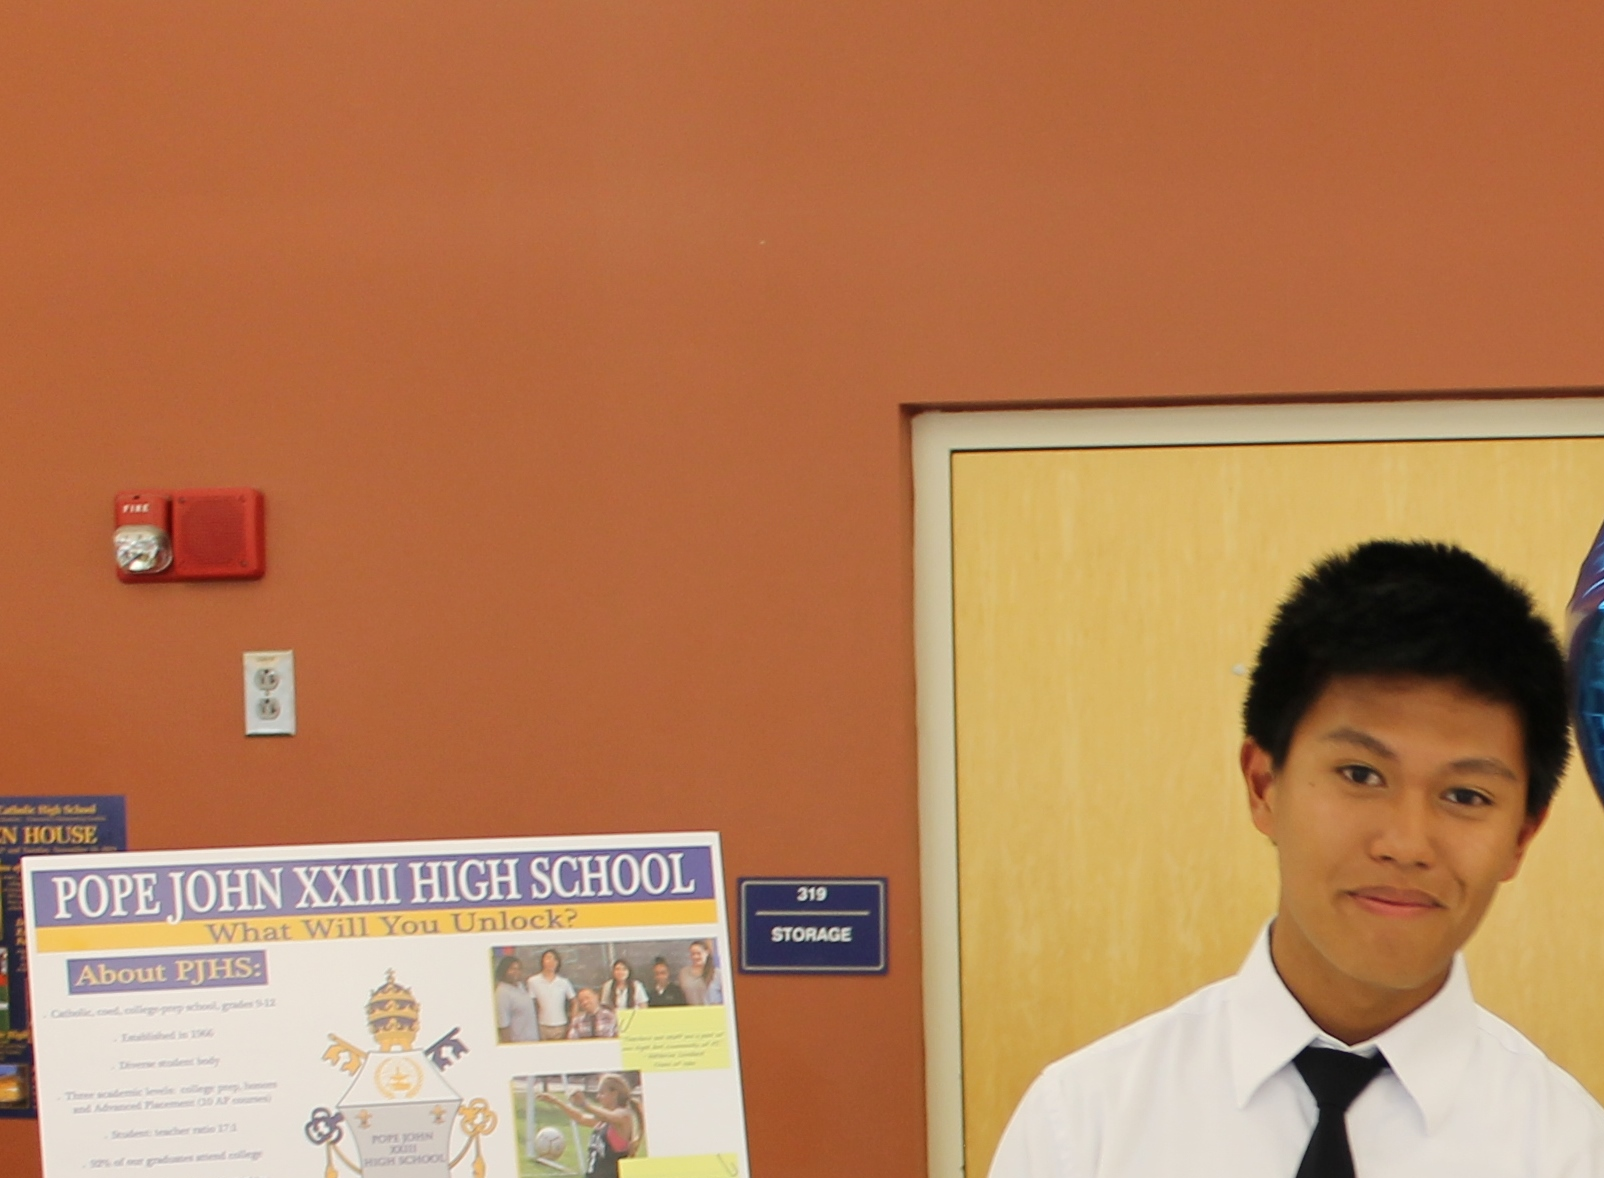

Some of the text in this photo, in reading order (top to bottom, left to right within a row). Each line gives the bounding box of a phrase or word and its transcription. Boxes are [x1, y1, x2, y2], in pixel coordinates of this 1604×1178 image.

[123, 504, 150, 514] FIRE
[37, 805, 60, 816] High
[63, 804, 97, 814] School
[23, 825, 98, 844] HOUSE
[52, 872, 161, 919] POPE
[167, 867, 284, 924] JOHN
[293, 861, 401, 909] XXIII
[408, 858, 522, 904] HIGH
[530, 852, 697, 900] SCHOOL
[797, 886, 827, 902] 319
[205, 908, 578, 943] What Will You Unlock?
[771, 926, 852, 943] STORAGE
[75, 956, 262, 987] About PJHS:
[221, 1000, 253, 1013] grades
[121, 1030, 177, 1042] Established
[178, 1030, 188, 1040] in
[118, 1056, 220, 1070] Diverse student body
[65, 1090, 96, 1100] Three
[97, 1087, 142, 1099] academic
[181, 1083, 214, 1096] college
[243, 1080, 277, 1090] honors
[73, 1104, 92, 1114] and
[93, 1102, 141, 1113] Advanced
[143, 1099, 195, 1110] Placement
[154, 1126, 191, 1137] teacher
[192, 1125, 216, 1135] ratio
[371, 1132, 434, 1145] POPE JOHN
[113, 1156, 125, 1167] of
[126, 1157, 144, 1167] our
[145, 1154, 194, 1169] graduates
[228, 1149, 263, 1162] college
[364, 1154, 447, 1168] HIGH SCHOOL
